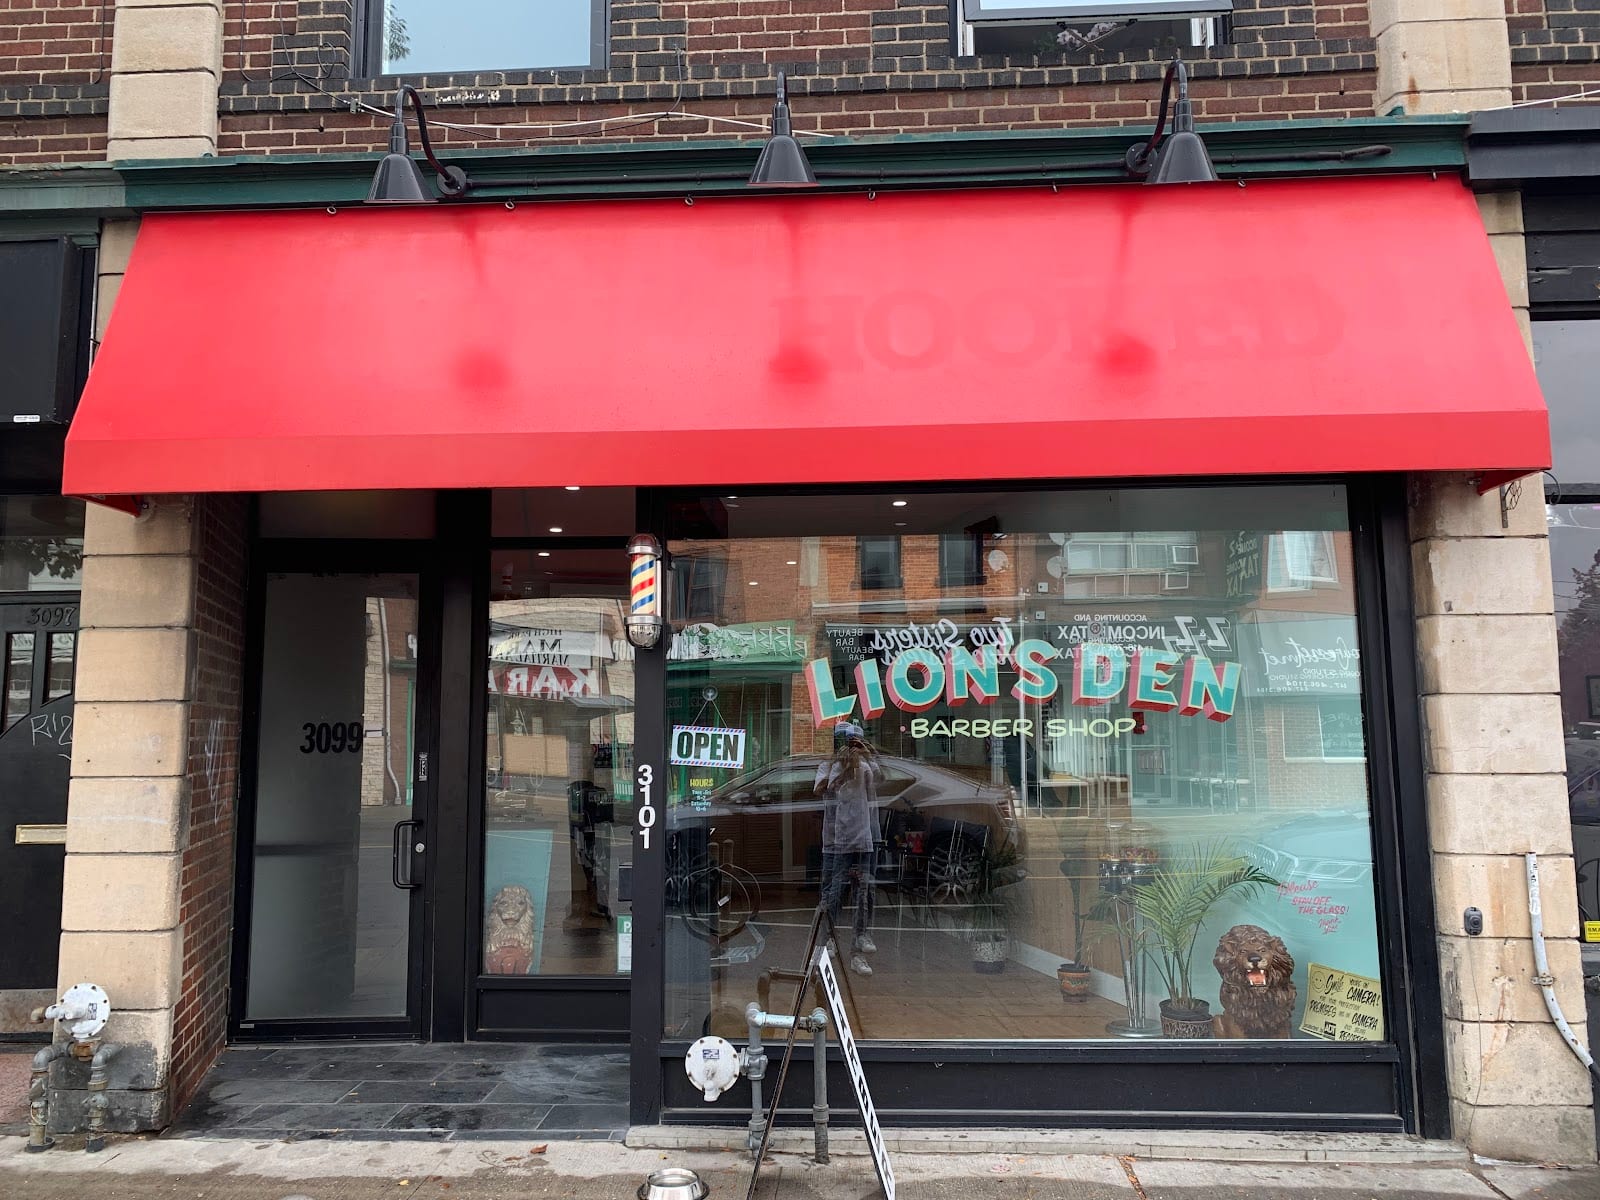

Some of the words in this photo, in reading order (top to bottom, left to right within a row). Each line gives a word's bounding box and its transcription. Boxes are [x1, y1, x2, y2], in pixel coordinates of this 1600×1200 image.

[27, 605, 77, 626] 3097
[1072, 649, 1242, 723] DEN
[300, 721, 363, 753] 3099
[911, 718, 1035, 739] BARBER
[1046, 717, 1137, 739] SHOP
[675, 730, 740, 762] OPEN
[690, 778, 714, 788] HOURS
[637, 764, 656, 849] 3101
[1297, 906, 1314, 915] THE
[1316, 905, 1350, 914] GLASS!
[1346, 987, 1381, 1008] CAMERA!
[1309, 999, 1337, 1018] PREMISES
[1351, 1012, 1379, 1031] CAMERA
